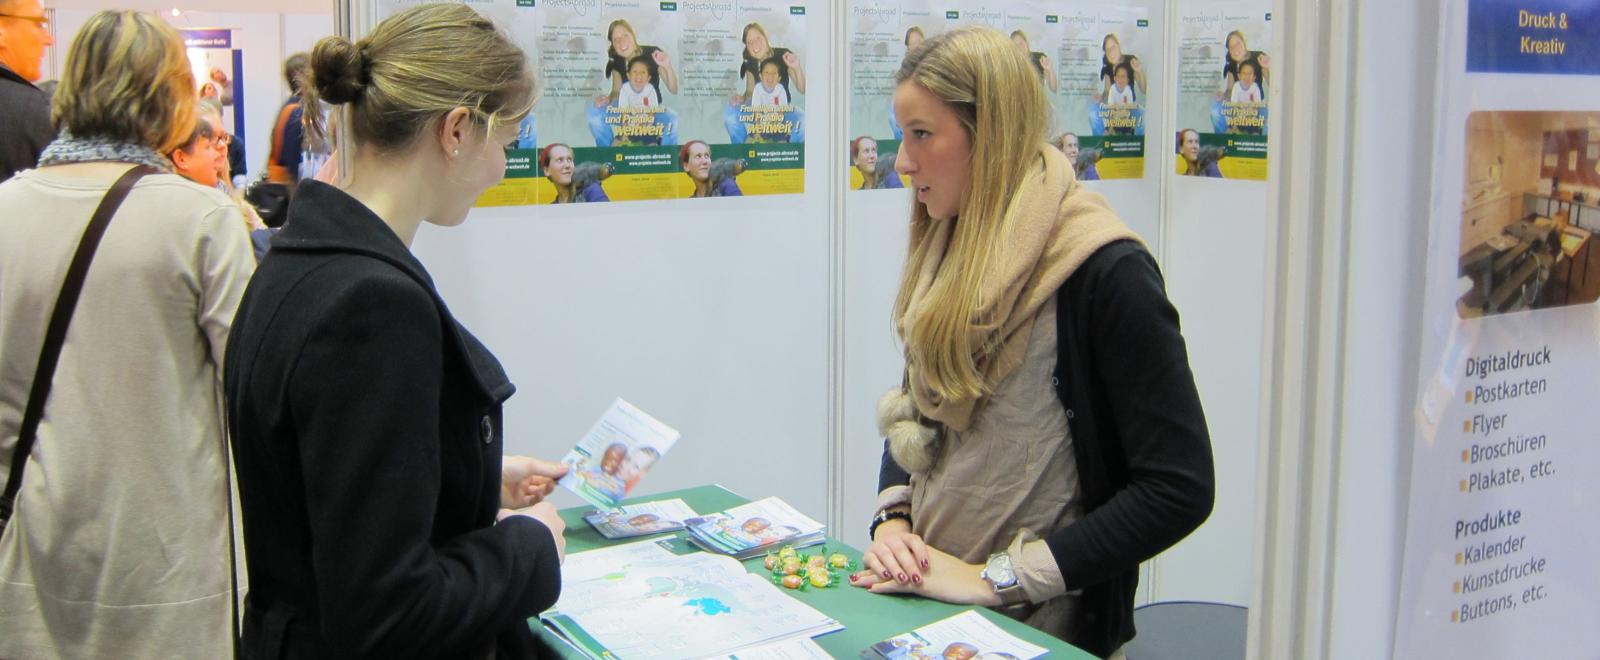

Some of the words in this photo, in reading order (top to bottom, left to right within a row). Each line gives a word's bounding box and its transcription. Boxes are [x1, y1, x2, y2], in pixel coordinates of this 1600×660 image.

[1518, 9, 1556, 29] Druck
[1559, 12, 1569, 30] &
[1520, 35, 1565, 55] Kreativ
[605, 114, 622, 124] und
[614, 122, 664, 137] weltweit
[739, 112, 755, 122] und
[746, 120, 792, 135] weltweit
[1465, 345, 1551, 379] Digitaldruck
[1474, 378, 1547, 405] Postkarten
[1472, 413, 1508, 437] Flyer
[1470, 434, 1546, 464] Broschüren
[1468, 467, 1525, 493] Plakate,
[1529, 460, 1556, 479] etc.
[1455, 509, 1522, 540] Produkte
[1464, 535, 1526, 566] Kalender
[1461, 556, 1547, 594] Kunstdrucke
[1459, 594, 1517, 623] Buttons,
[1521, 584, 1548, 604] etc.
